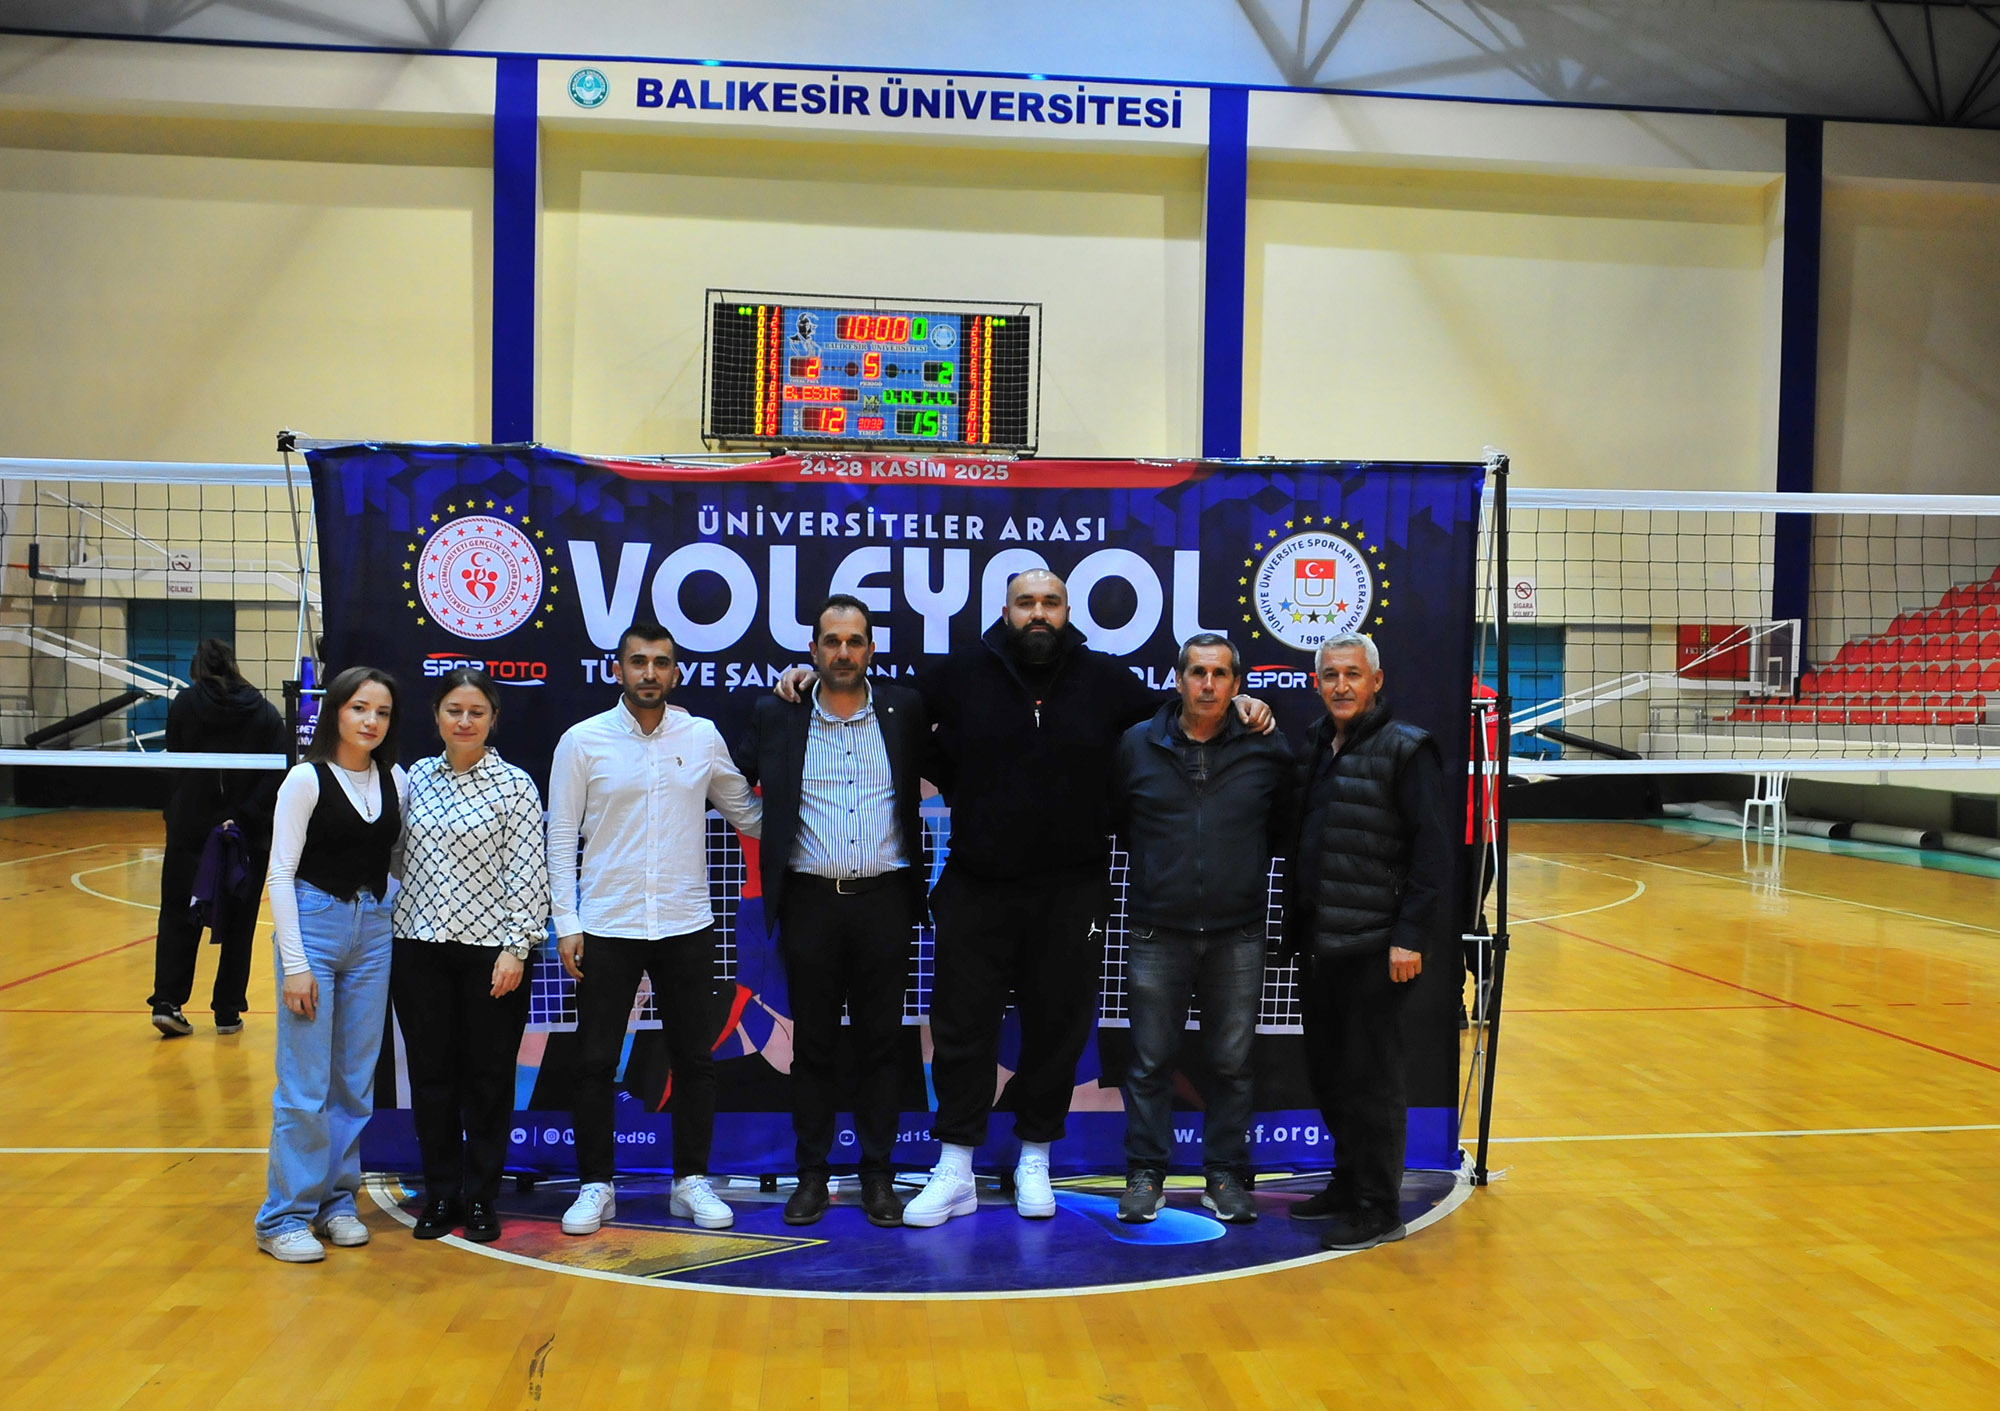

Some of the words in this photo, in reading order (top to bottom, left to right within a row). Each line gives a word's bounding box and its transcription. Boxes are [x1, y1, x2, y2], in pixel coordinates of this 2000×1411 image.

[636, 74, 871, 116] BALIKESİR
[880, 77, 1182, 129] ÜNİVERSİTESİ
[758, 306, 766, 316] 0
[758, 316, 765, 327] 0
[985, 316, 992, 326] 0
[757, 327, 765, 337] 0
[845, 315, 909, 343] 10:00
[985, 327, 992, 337] 0
[757, 338, 765, 348] 0
[985, 337, 992, 348] 0
[757, 348, 765, 359] 0
[984, 348, 992, 358] 0
[757, 359, 764, 370] 0
[805, 357, 821, 379] 2
[864, 352, 880, 379] 5
[984, 358, 991, 369] 0
[756, 370, 764, 380] 0
[938, 361, 953, 384] 2
[984, 369, 991, 379] 0
[756, 381, 764, 391] 0
[984, 380, 991, 390] 0
[756, 391, 763, 402] 0
[983, 390, 991, 401] 0
[756, 402, 763, 413] 0
[983, 401, 991, 411] 0
[755, 413, 763, 423] 0
[820, 407, 845, 432] 12
[983, 411, 990, 422] 0
[755, 424, 763, 434] 0
[913, 410, 938, 437] 15
[983, 422, 990, 432] 0
[982, 433, 990, 443] 0
[800, 460, 863, 477] 24-28
[954, 464, 1009, 480] 2025
[698, 505, 984, 540] ÜNİVERSİTELER
[1000, 515, 1105, 541] ARASI
[1307, 538, 1356, 563] SPORLARI
[508, 559, 518, 579] SPOR
[1259, 540, 1305, 588] ÜNİVERSİTE
[1340, 563, 1367, 633] FEDERASYONU
[1260, 591, 1285, 633] TÜRKİYE
